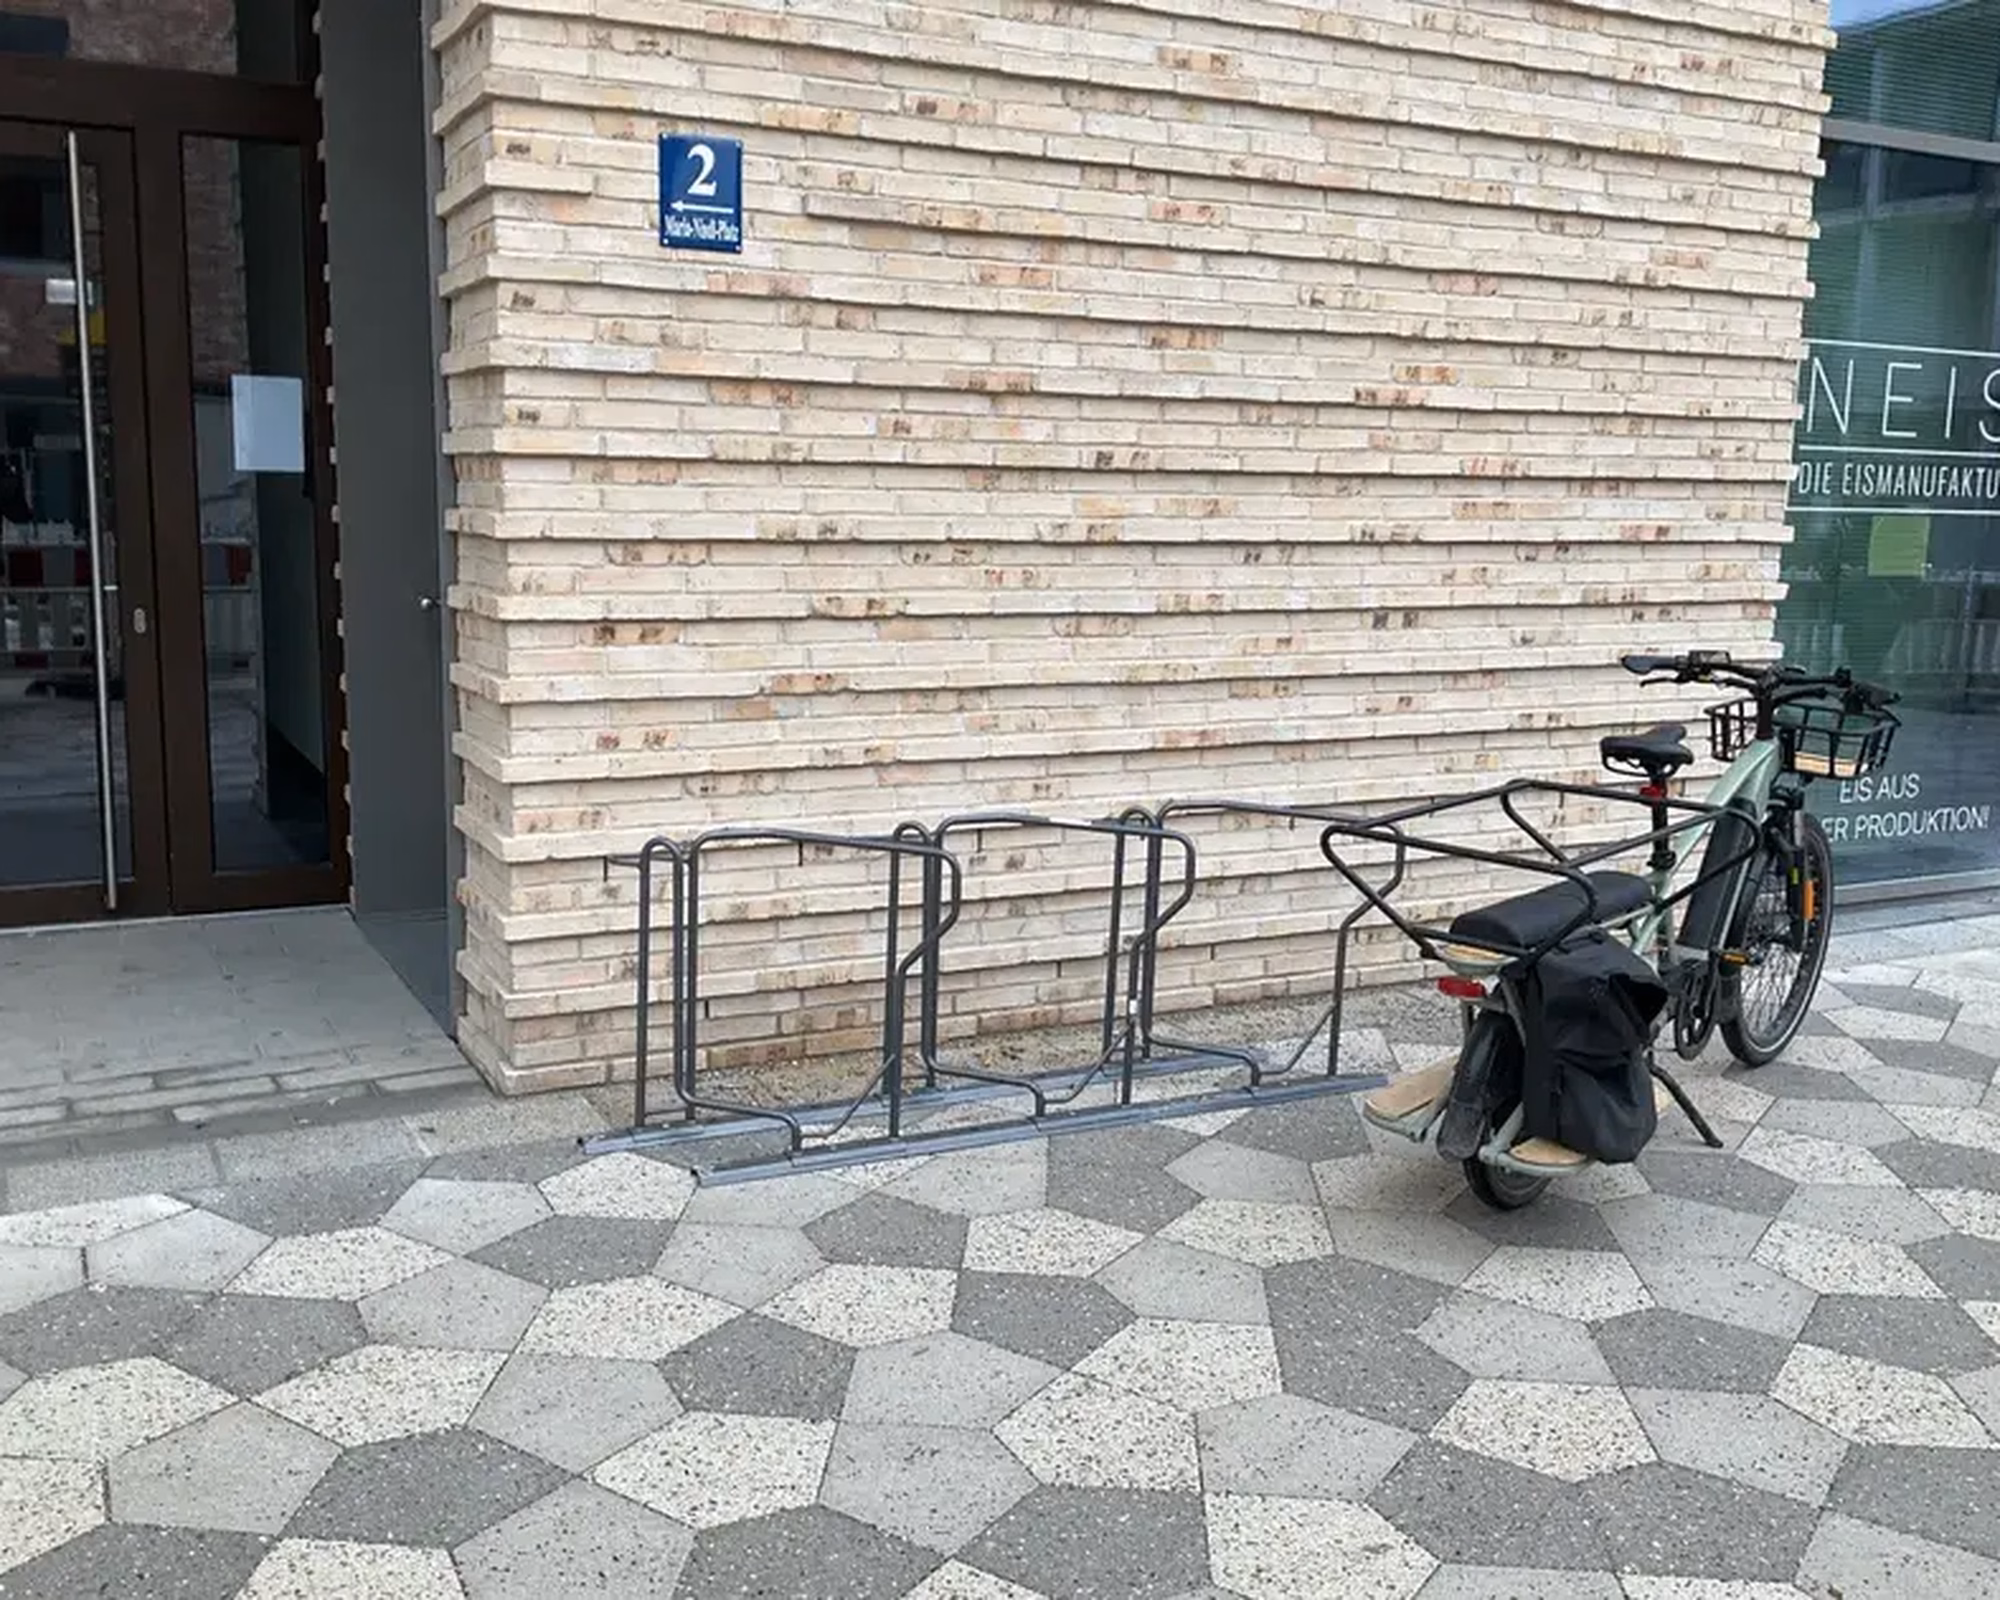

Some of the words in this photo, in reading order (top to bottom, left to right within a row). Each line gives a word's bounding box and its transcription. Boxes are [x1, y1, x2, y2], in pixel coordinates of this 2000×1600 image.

[687, 143, 717, 197] 2
[1806, 356, 2000, 443] NEIS
[1798, 461, 1833, 494] DIE
[1842, 463, 2000, 499] EISMANUFAKTU
[1839, 776, 1874, 804] EIS
[1876, 773, 1920, 800] AUS
[1854, 805, 1990, 841] PRODUKTION!
